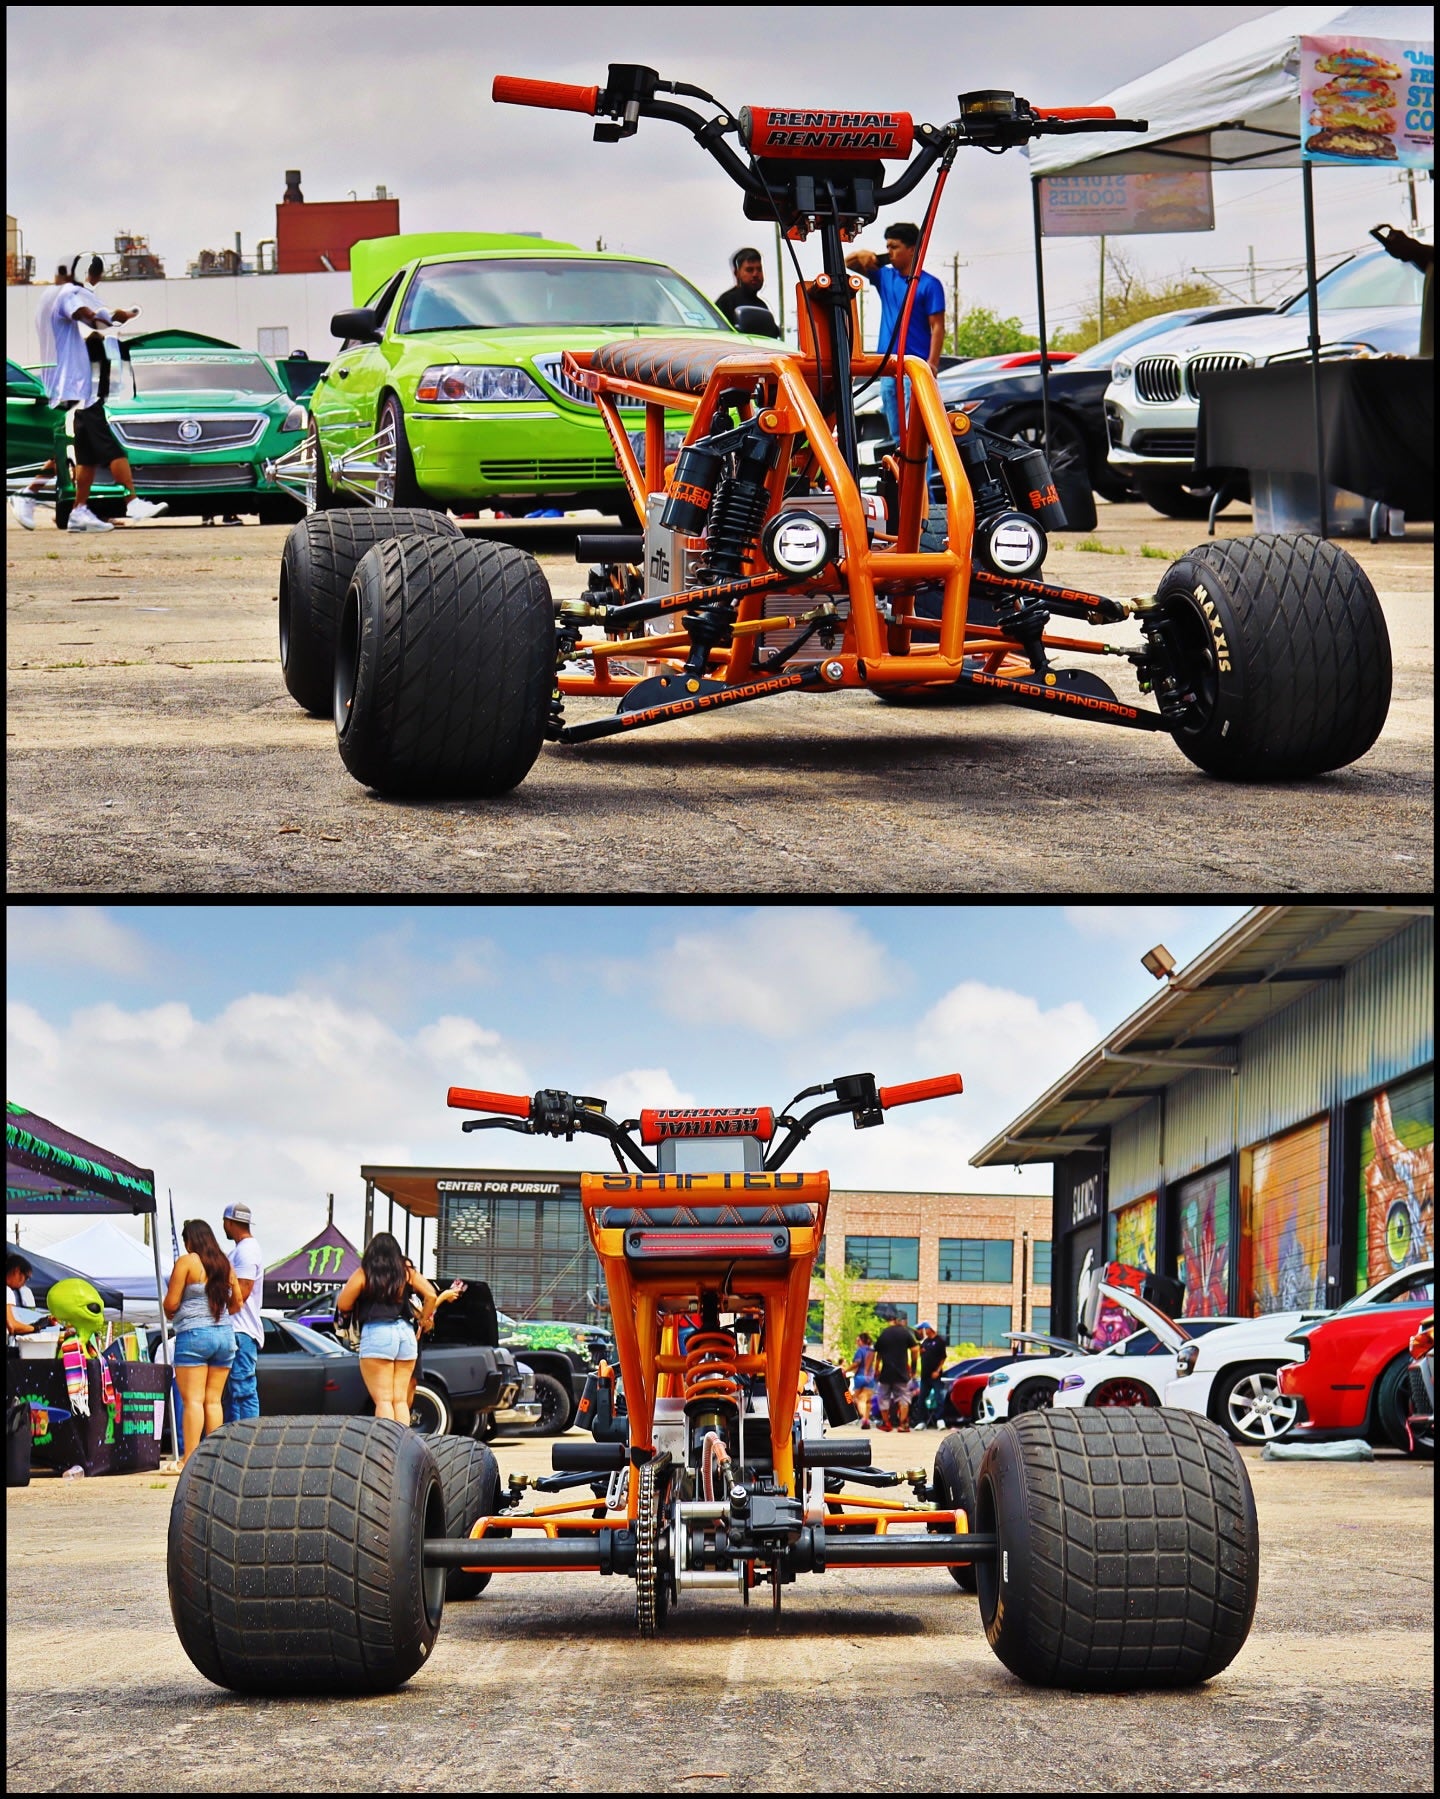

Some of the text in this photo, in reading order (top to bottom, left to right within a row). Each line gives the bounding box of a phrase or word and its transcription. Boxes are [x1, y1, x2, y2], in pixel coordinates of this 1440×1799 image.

[767, 112, 898, 128] RENTHAL
[766, 131, 898, 148] RENTHAL
[661, 583, 731, 608] DEATH
[976, 571, 1043, 592] DEATH
[1061, 589, 1100, 606] GAS
[1193, 584, 1231, 672] MAXXIS
[698, 674, 802, 707] STANDARDS
[1045, 689, 1137, 718] STANDARDS
[655, 1118, 760, 1136] RENTHAL
[437, 1181, 559, 1194] CENTER FOR PURSUIT
